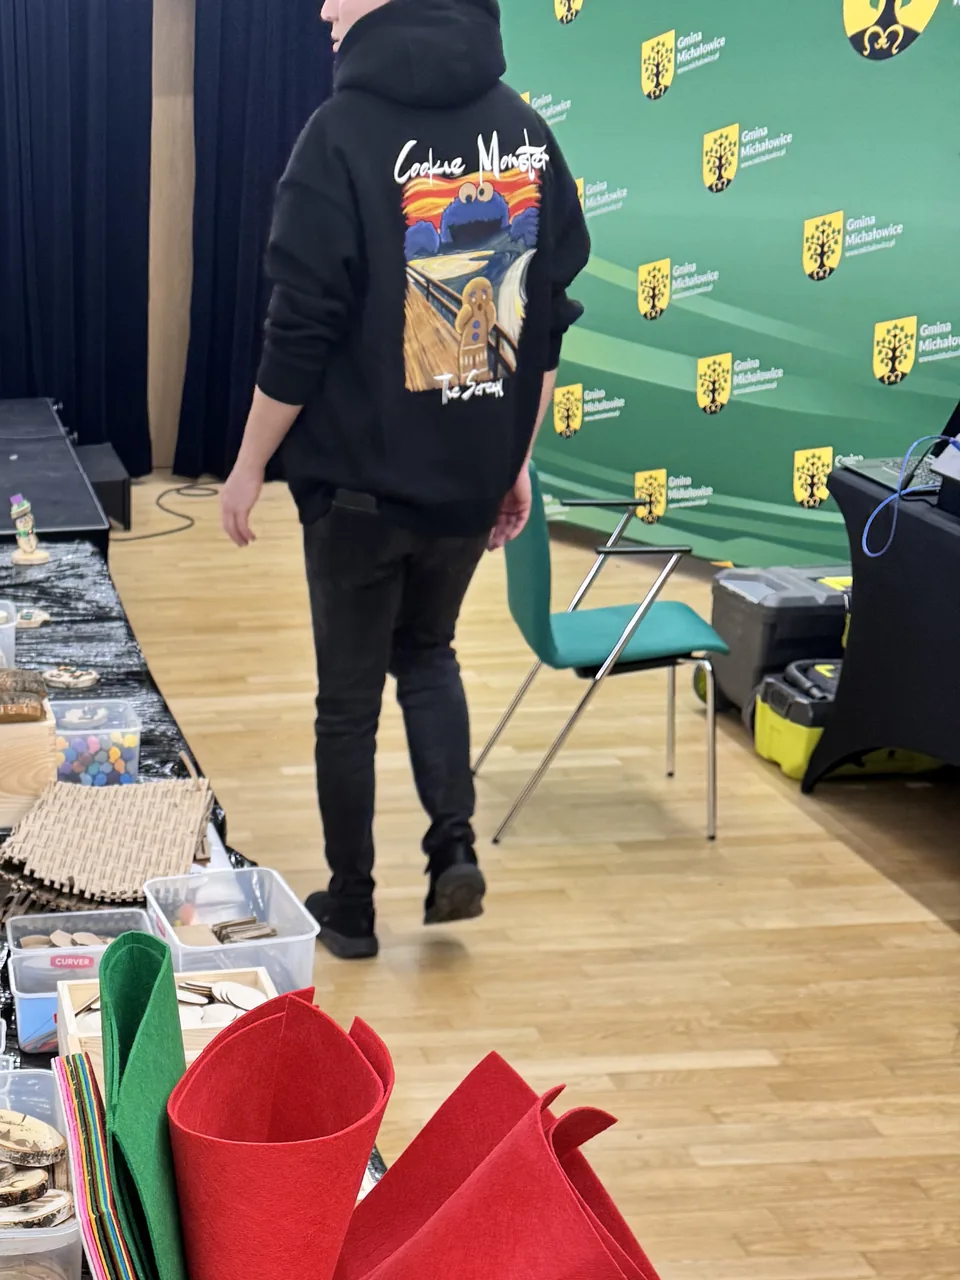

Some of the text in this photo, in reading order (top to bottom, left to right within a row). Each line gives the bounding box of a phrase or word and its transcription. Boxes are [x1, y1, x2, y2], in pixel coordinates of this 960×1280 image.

[677, 31, 703, 49] Gmina
[741, 126, 768, 143] Gmina
[393, 128, 550, 186] Cookie Monster
[846, 215, 876, 231] Gmina
[845, 223, 904, 247] Michałowice
[672, 262, 697, 277] Gmina
[920, 320, 952, 337] Gmina
[55, 958, 90, 966] CURVER
